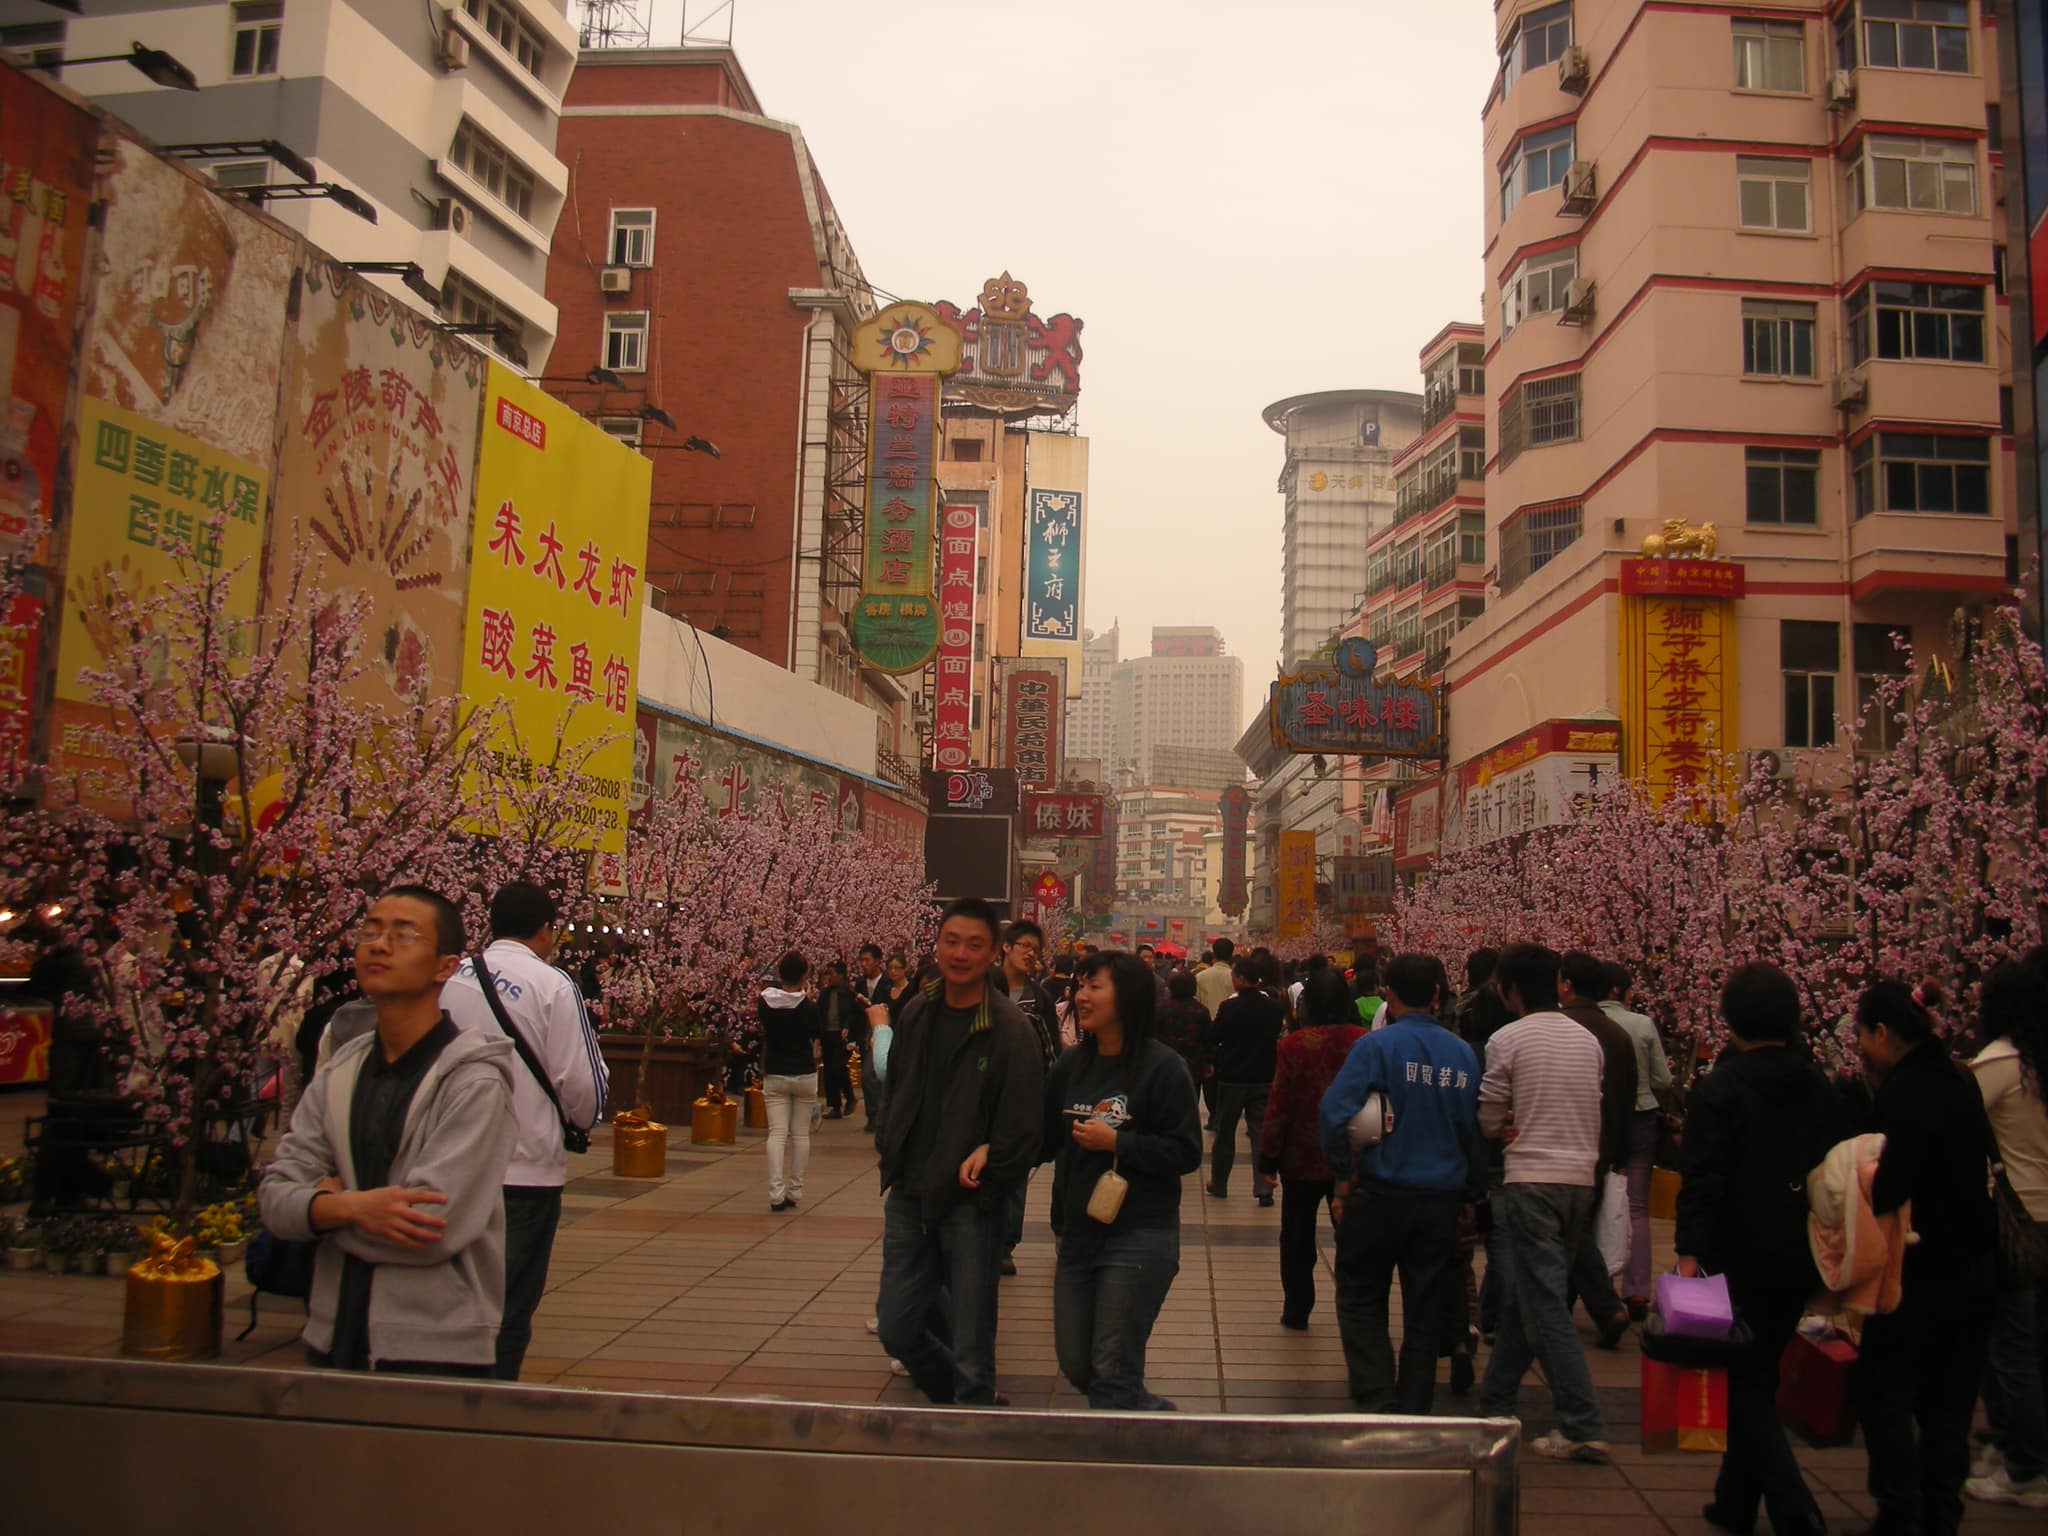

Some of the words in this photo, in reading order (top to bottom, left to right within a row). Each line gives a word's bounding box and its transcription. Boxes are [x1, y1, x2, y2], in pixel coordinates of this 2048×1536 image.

[303, 365, 463, 518] 金陵葫芦王
[343, 418, 376, 442] LING
[501, 403, 542, 446] 南京总店
[1366, 423, 1376, 436] P
[95, 419, 260, 526] 四季鲜水果
[878, 376, 921, 585] 亚特兰商务酒店
[488, 500, 637, 619] 朱太龙虾
[943, 537, 974, 621] 面点煌
[480, 607, 630, 713] 酸菜鱼馆
[938, 655, 970, 741] 面点煌
[1297, 690, 1422, 730] 圣味楼
[1034, 802, 1093, 831] 傣妹
